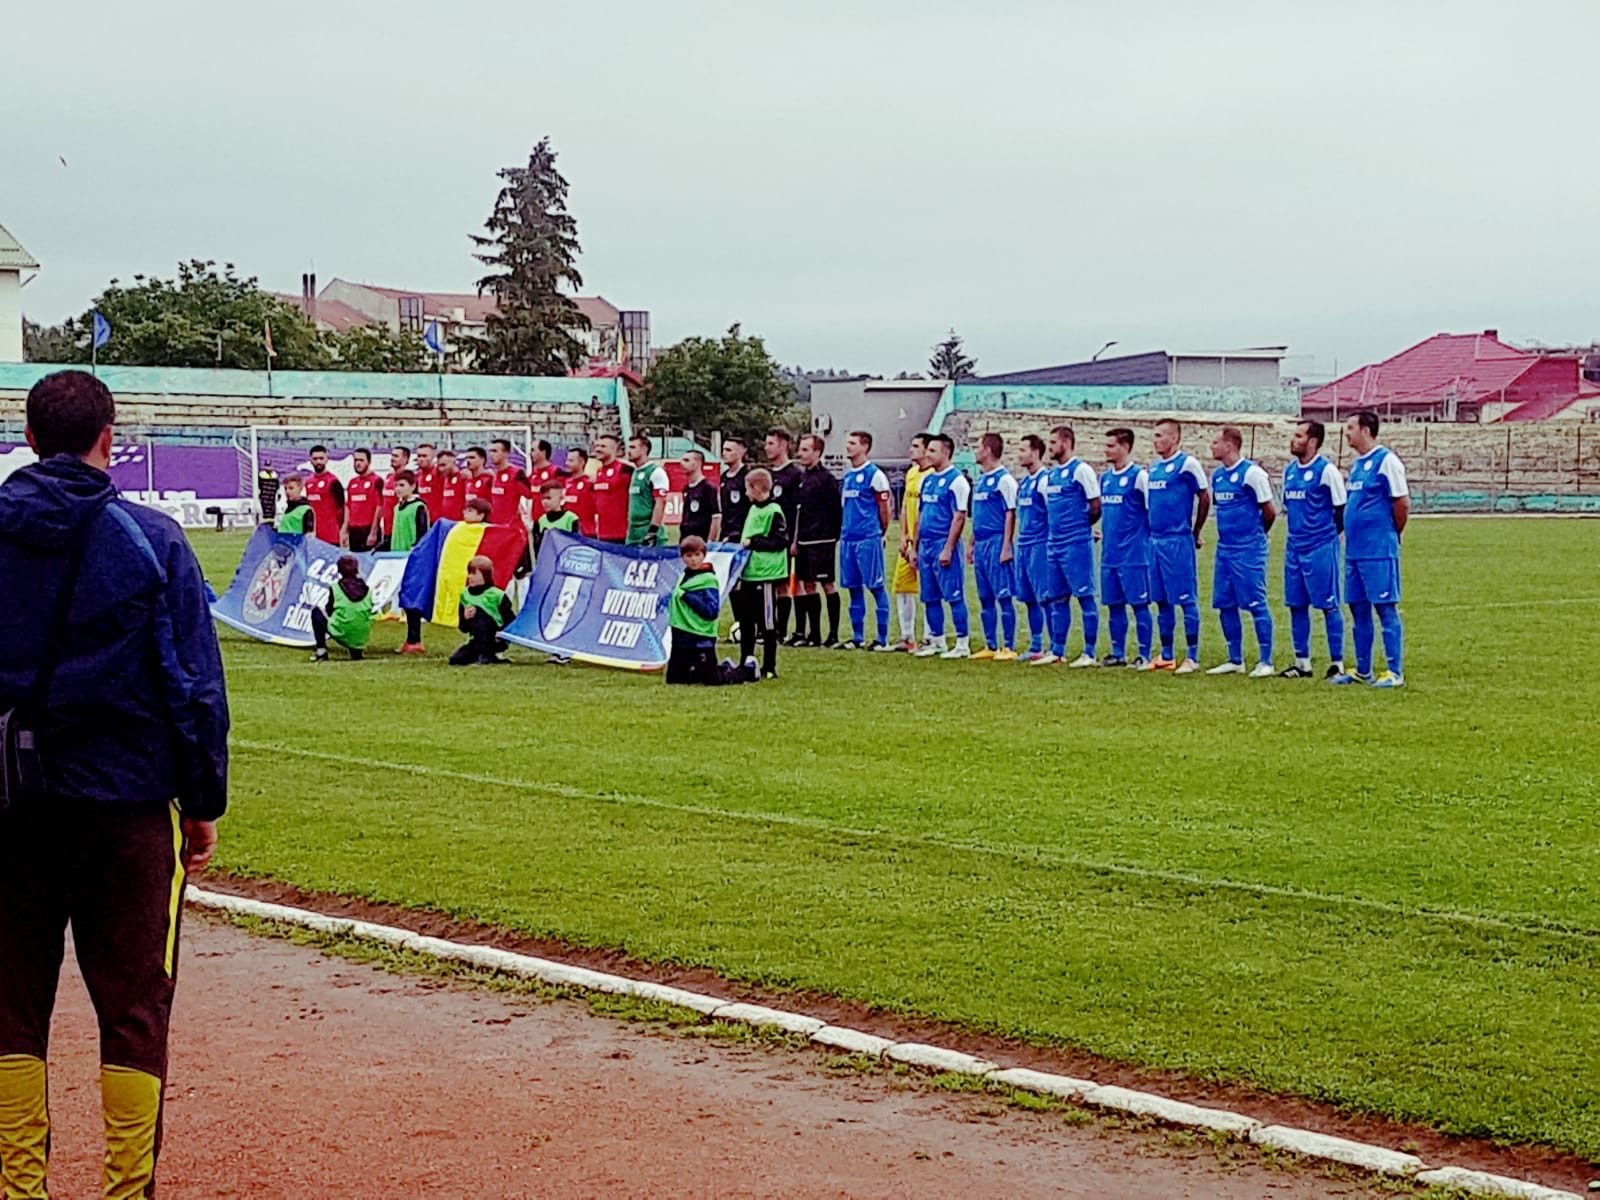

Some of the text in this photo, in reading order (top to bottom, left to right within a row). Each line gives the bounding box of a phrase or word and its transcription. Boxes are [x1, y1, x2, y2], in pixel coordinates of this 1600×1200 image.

[307, 559, 342, 584] A.C.
[601, 588, 661, 620] VIITORUL
[598, 620, 644, 648] LITENI
